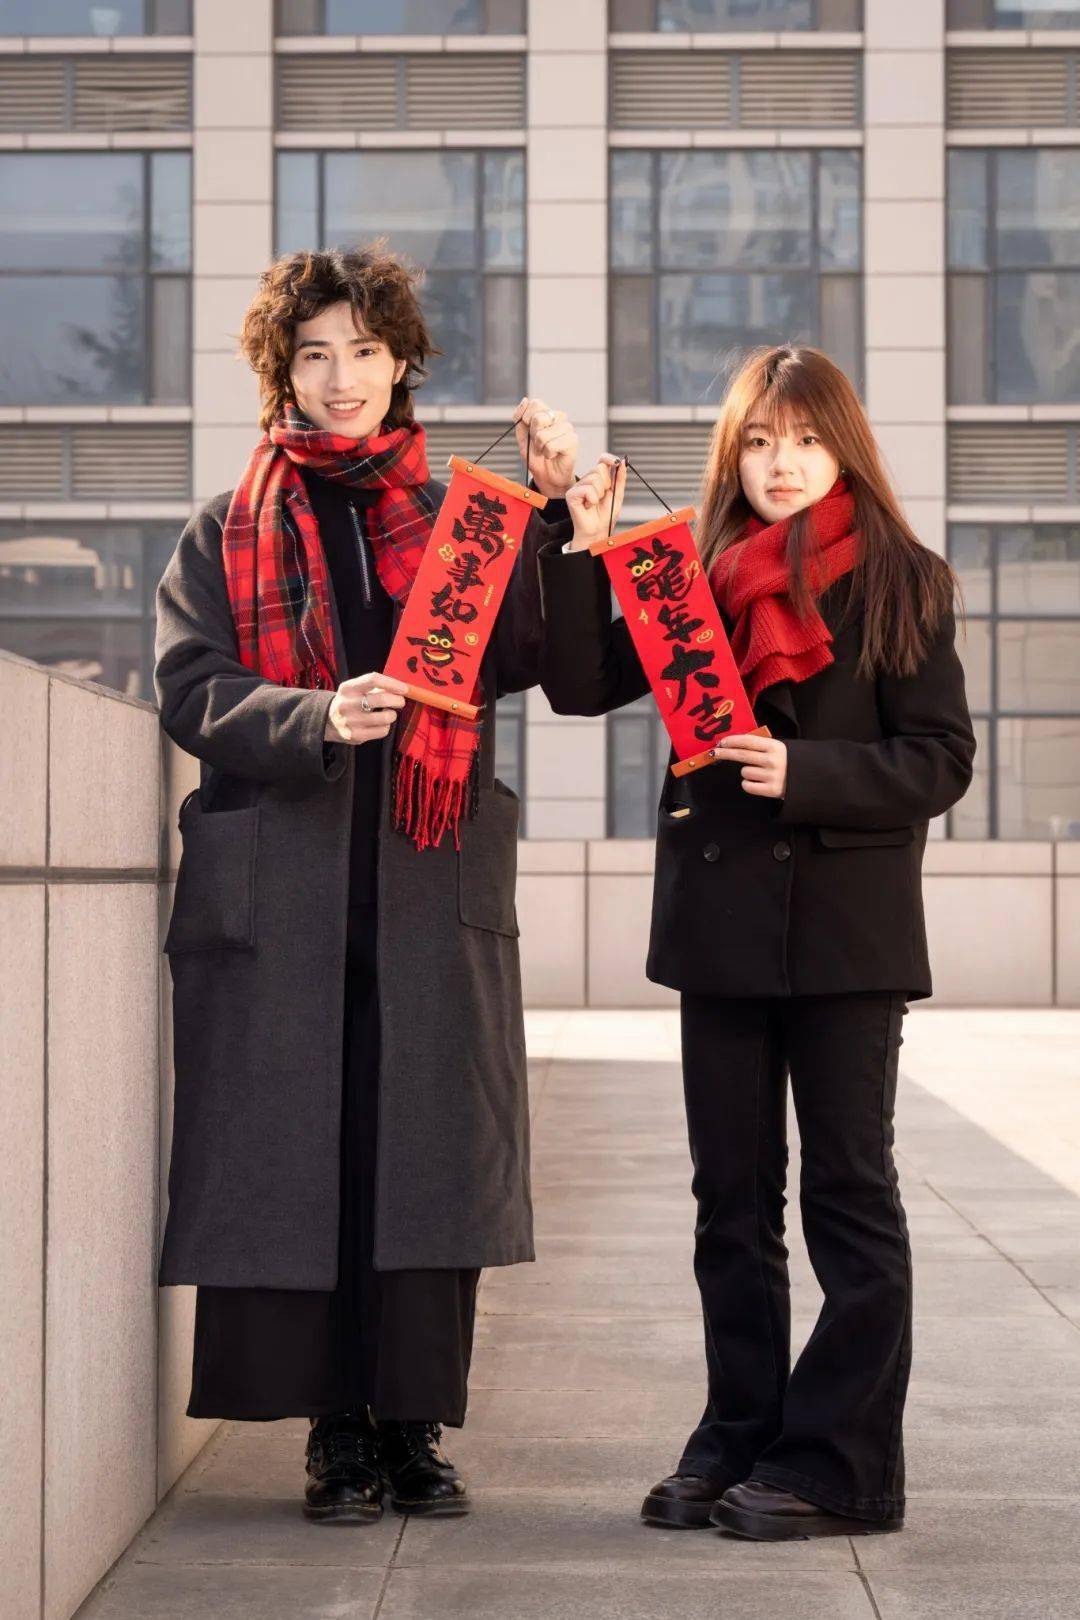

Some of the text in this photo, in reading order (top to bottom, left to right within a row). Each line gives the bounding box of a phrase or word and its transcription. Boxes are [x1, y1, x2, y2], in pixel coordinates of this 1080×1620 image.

[407, 491, 507, 686] 萬事如意
[625, 538, 733, 741] 龍年大吉
